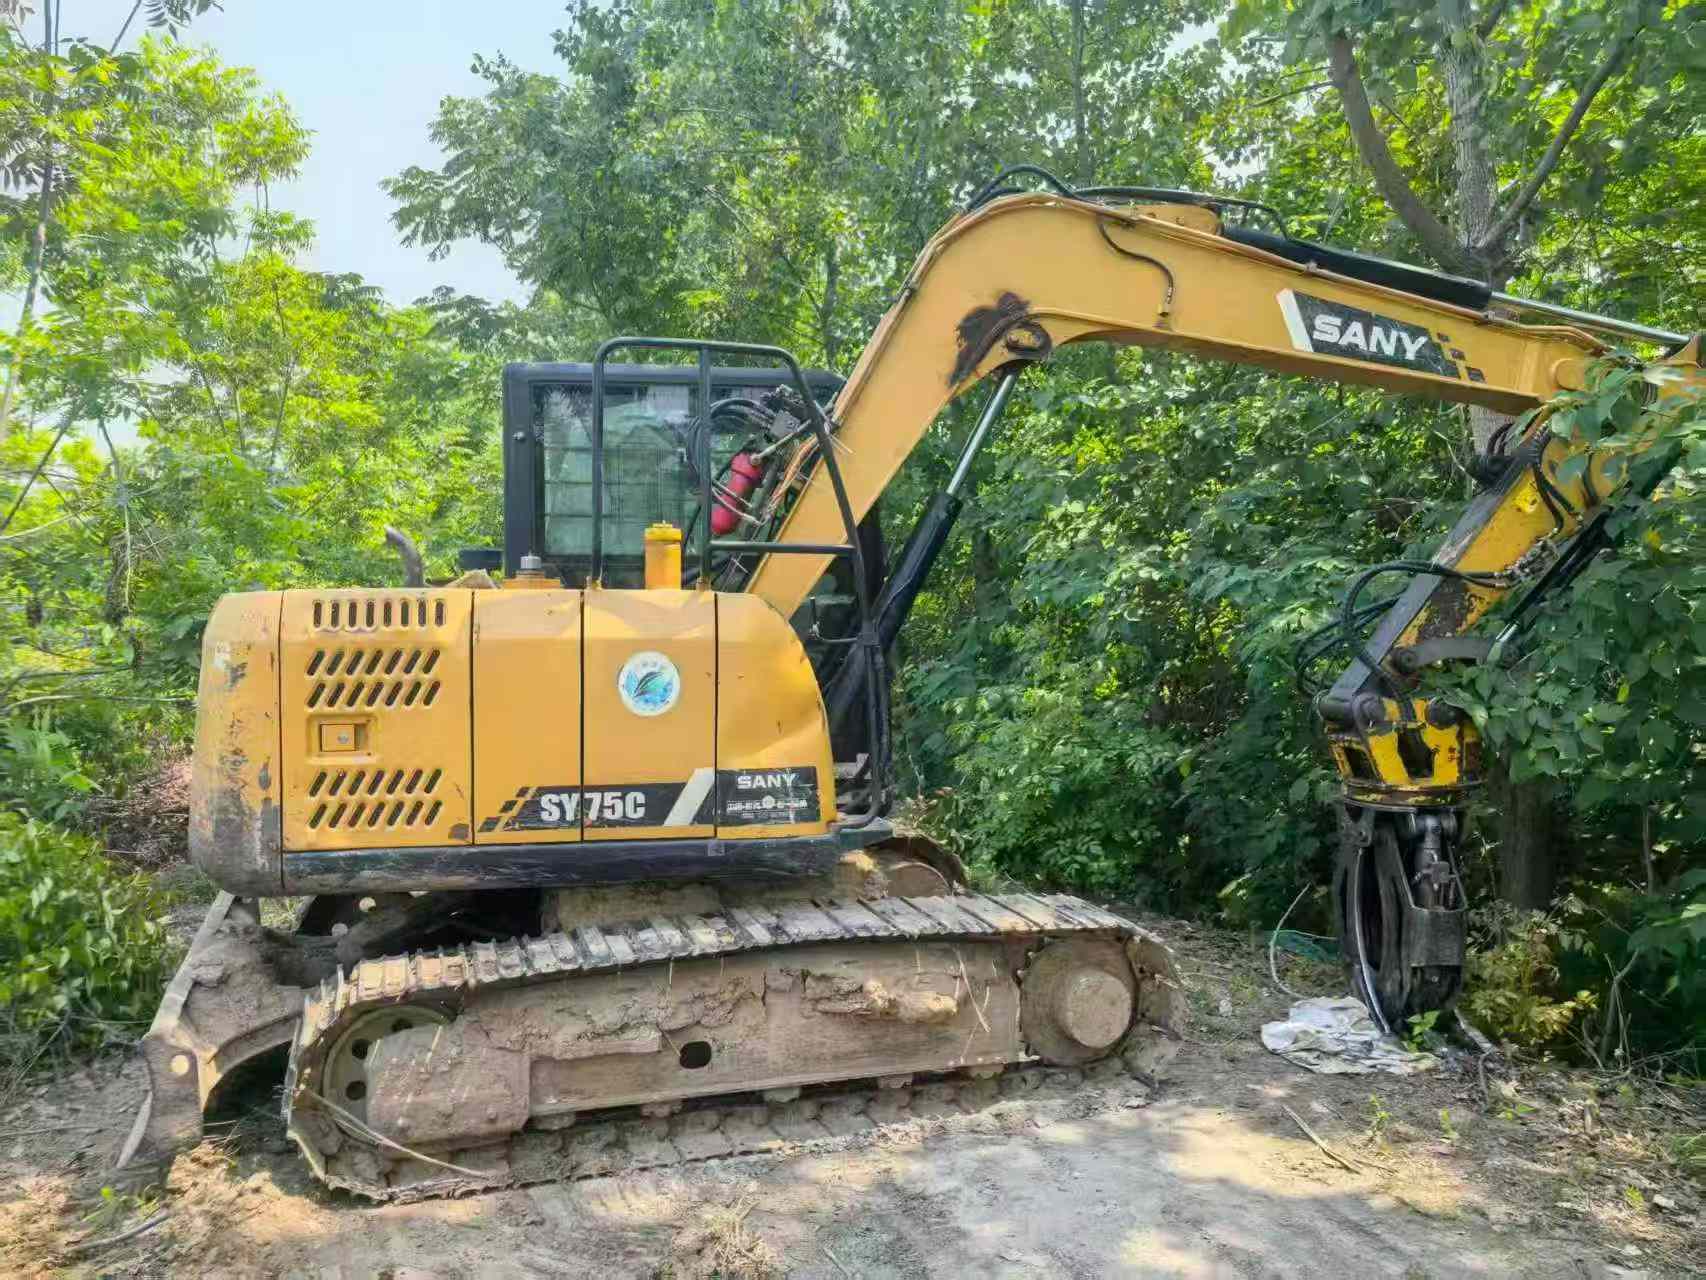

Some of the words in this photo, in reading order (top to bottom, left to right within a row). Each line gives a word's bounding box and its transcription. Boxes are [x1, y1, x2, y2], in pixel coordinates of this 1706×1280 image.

[1312, 313, 1428, 361] SANY
[737, 774, 797, 789] SANY
[540, 791, 646, 822] SY75C
